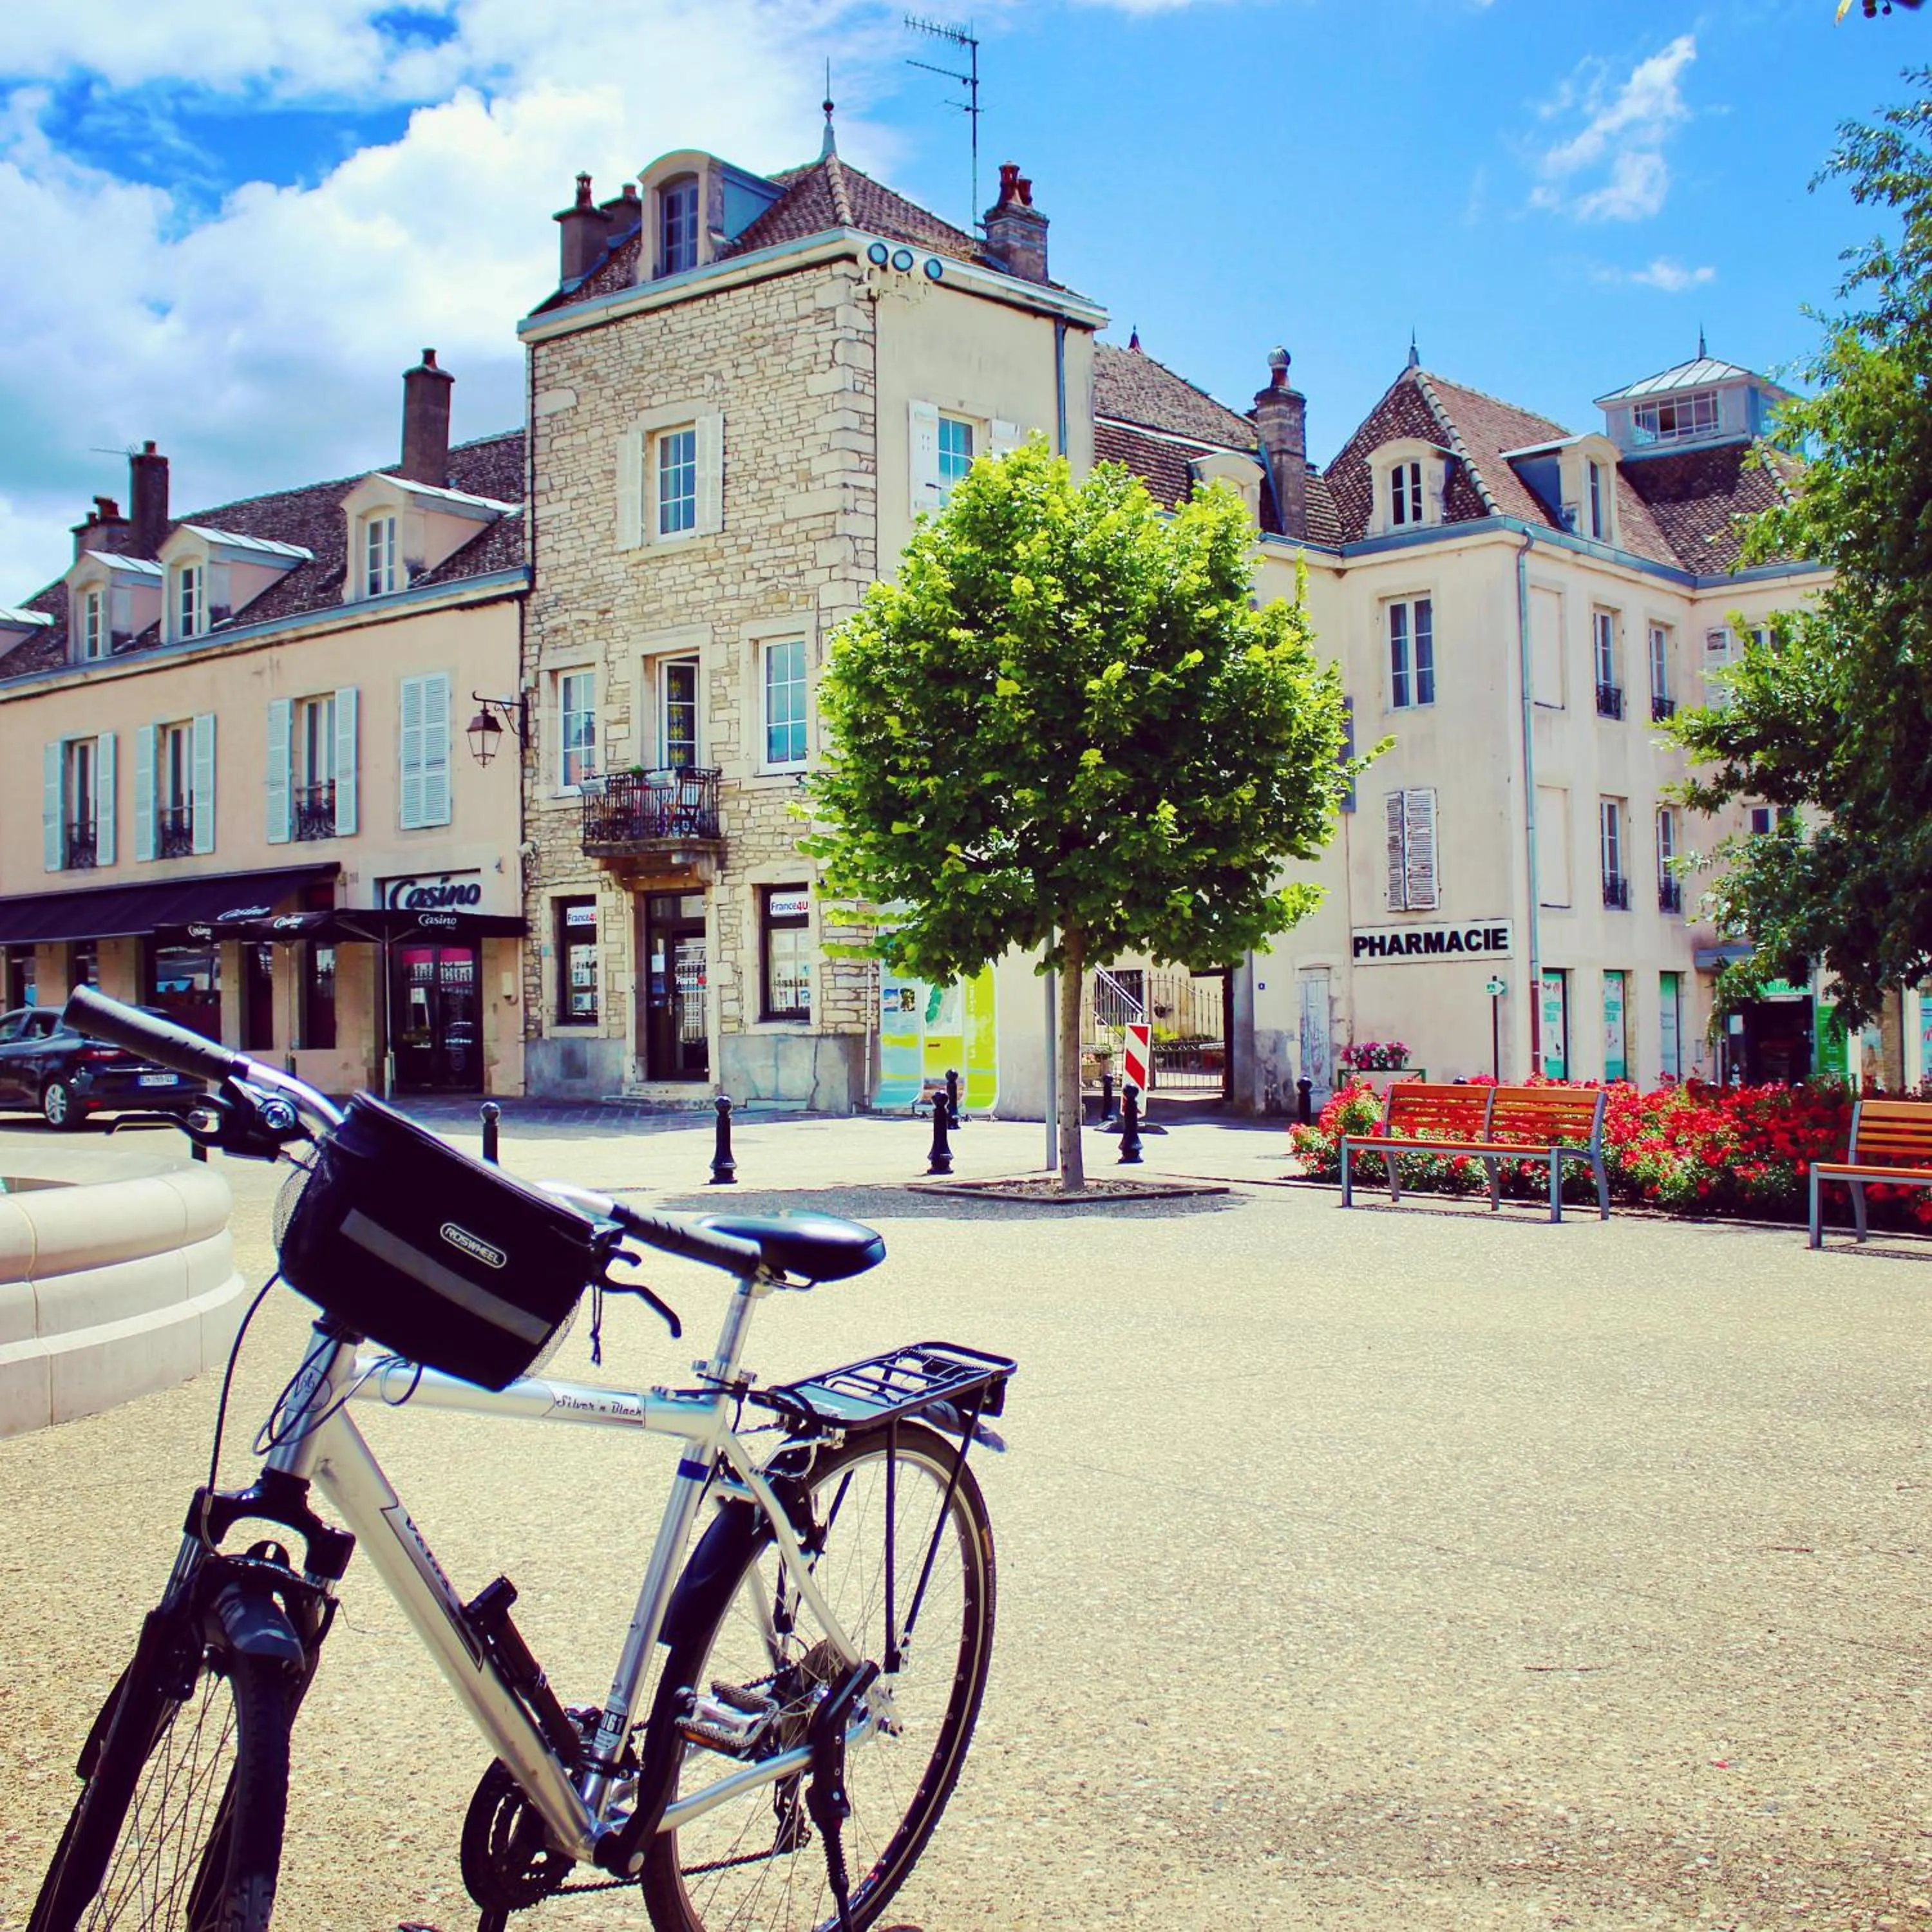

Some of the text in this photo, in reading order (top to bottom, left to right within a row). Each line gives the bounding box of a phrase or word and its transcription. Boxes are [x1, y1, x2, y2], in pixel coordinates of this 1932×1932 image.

[389, 876, 481, 909] Casino
[771, 900, 808, 911] France4U
[418, 913, 457, 927] Casino
[567, 913, 596, 923] France4
[1353, 928, 1509, 958] PHARMACIE
[445, 1227, 499, 1264] ROSWHEEL
[556, 1394, 594, 1412] Silver
[611, 1401, 642, 1417] Black
